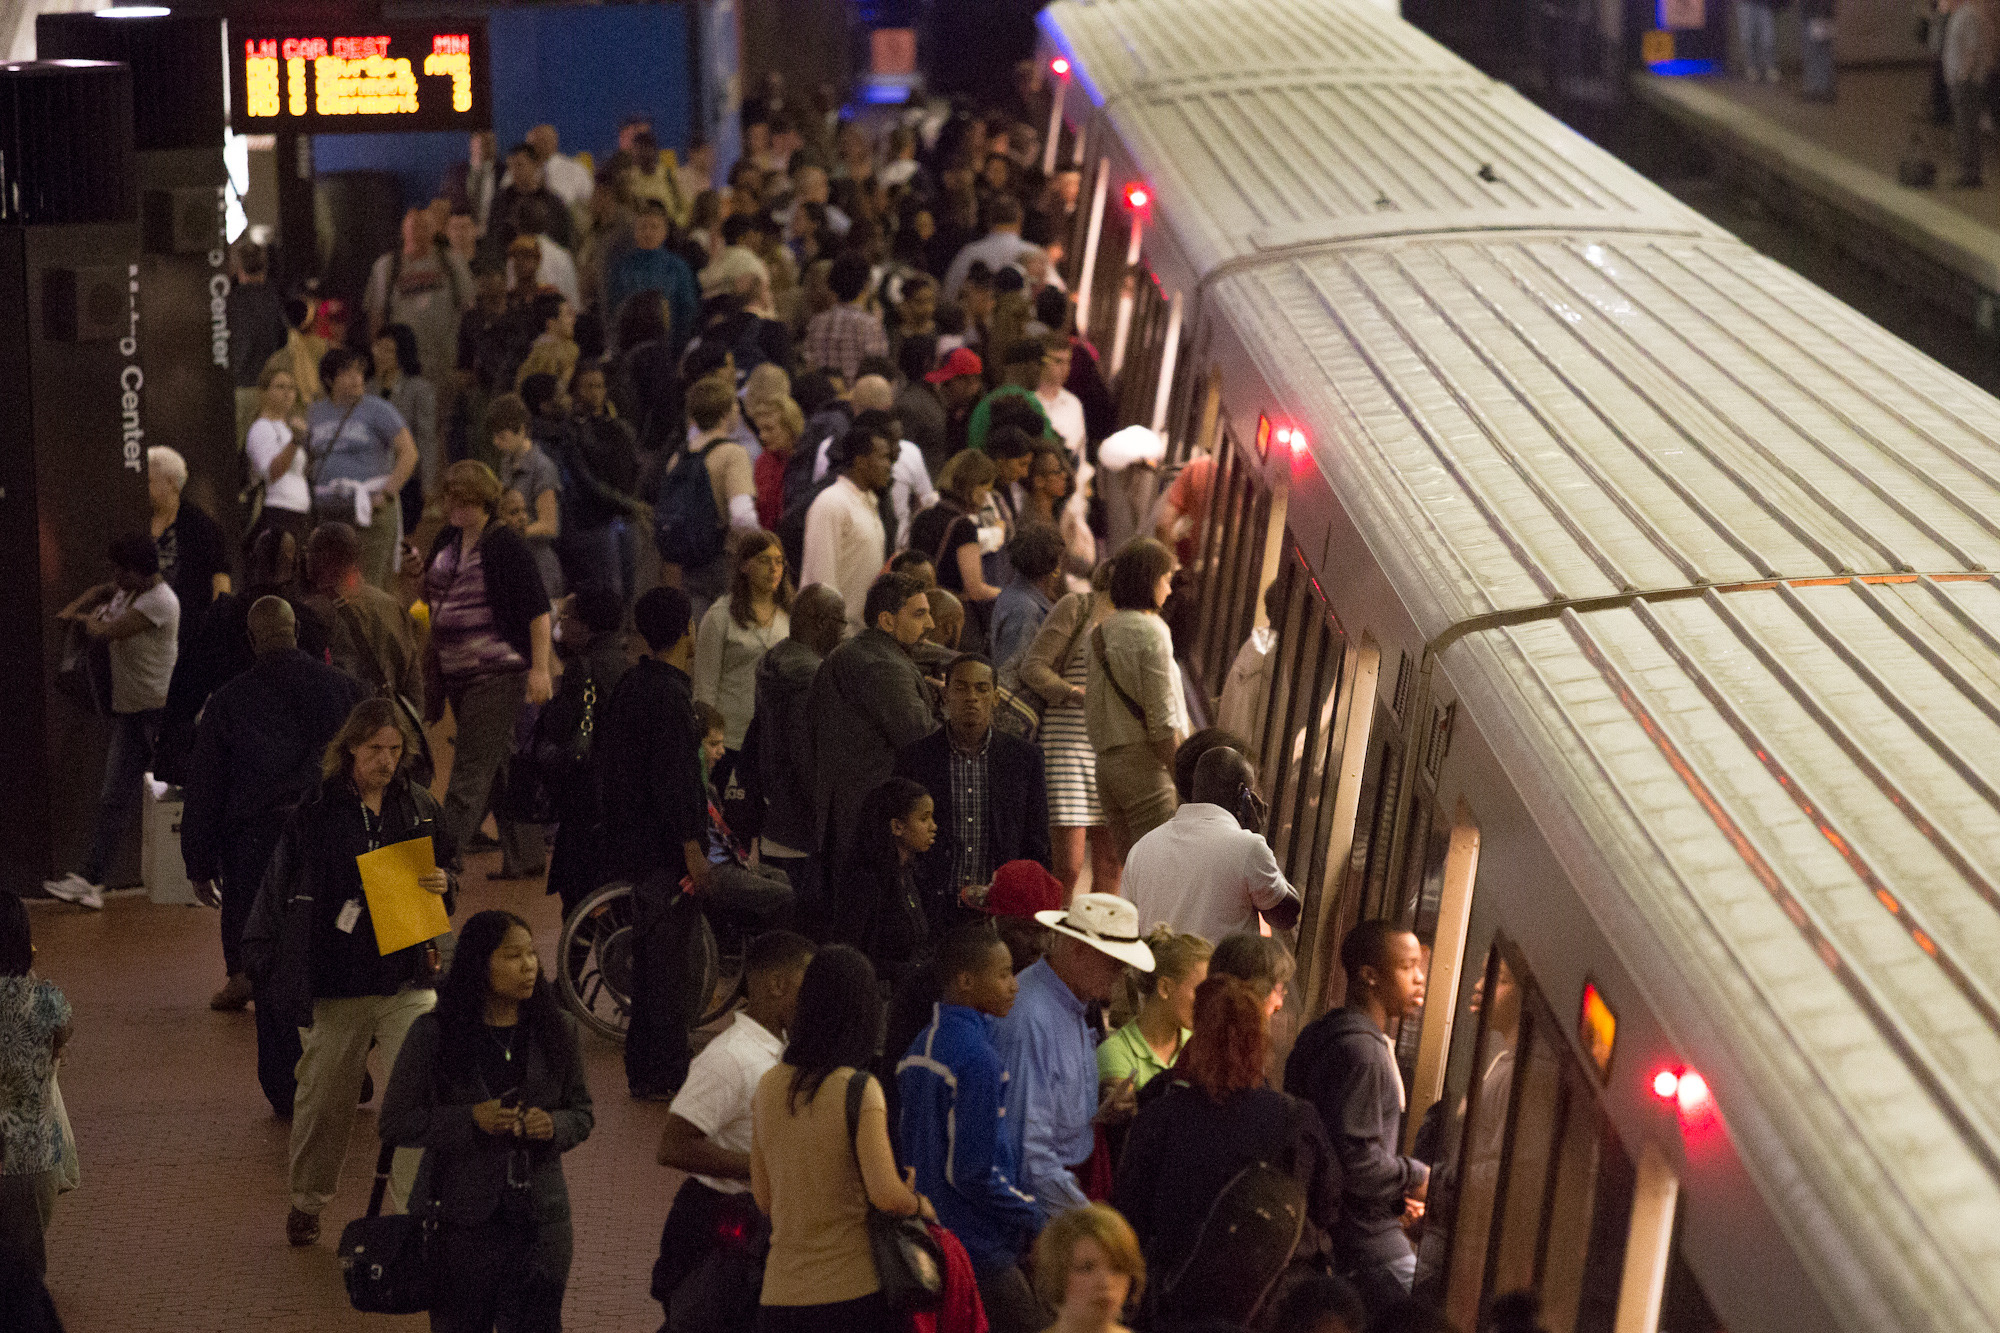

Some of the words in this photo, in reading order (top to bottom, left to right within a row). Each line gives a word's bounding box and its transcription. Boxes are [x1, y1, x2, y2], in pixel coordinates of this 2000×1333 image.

[282, 38, 327, 60] CAR
[332, 36, 391, 58] DEST
[433, 34, 469, 55] MIN
[209, 273, 230, 369] Center
[121, 365, 144, 473] Center
